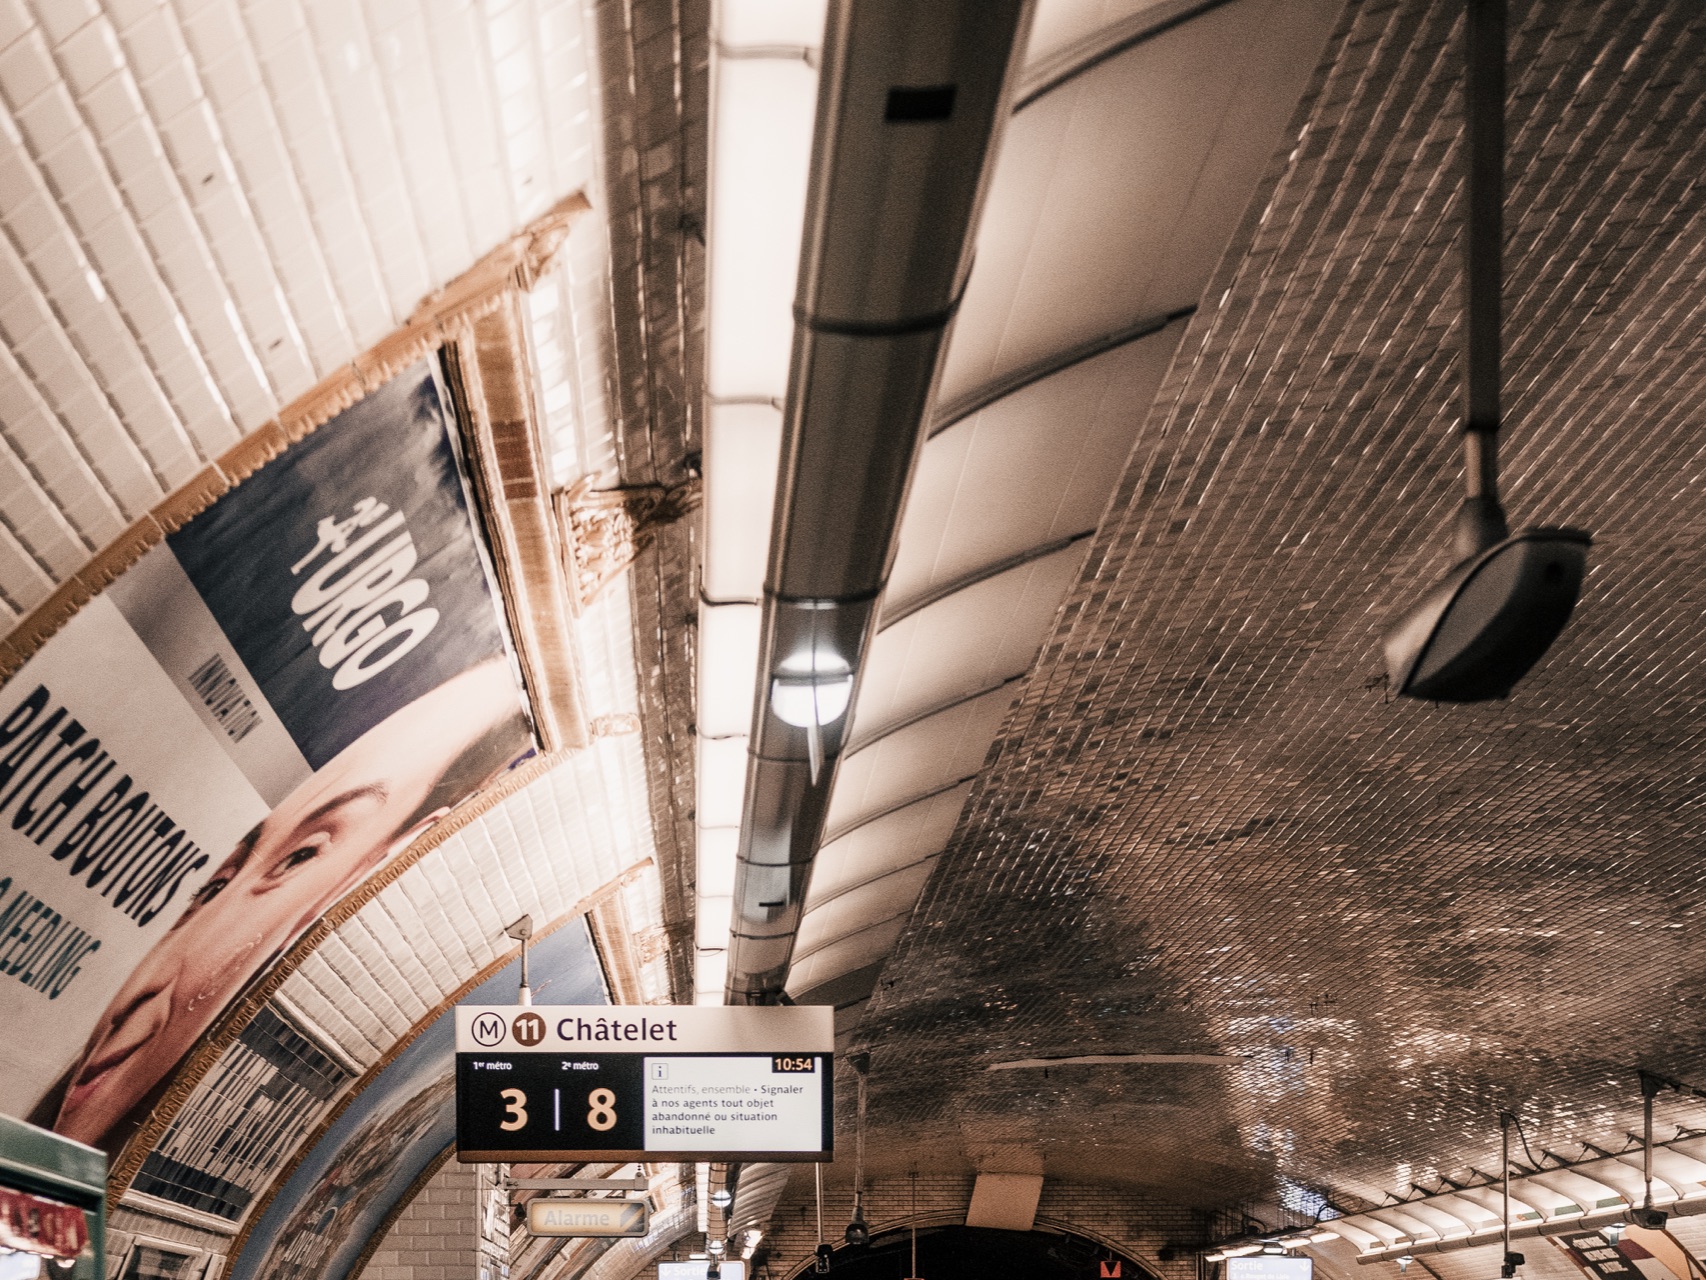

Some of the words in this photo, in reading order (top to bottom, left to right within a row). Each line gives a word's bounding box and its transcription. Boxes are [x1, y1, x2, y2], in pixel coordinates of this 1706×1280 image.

[187, 652, 264, 744] INNOVATION
[50, 774, 209, 927] BOUTONS
[516, 1018, 540, 1041] 11
[557, 1017, 677, 1041] Châtelet
[486, 1061, 513, 1070] métro
[573, 1061, 599, 1070] métro
[774, 1058, 813, 1071] 10:54
[652, 1085, 699, 1095] Attentifs,
[701, 1085, 751, 1094] ensemble
[760, 1085, 804, 1096] Signaler
[500, 1087, 529, 1132] 3
[587, 1087, 617, 1132] 8
[652, 1099, 658, 1108] à
[661, 1100, 680, 1108] nos
[683, 1099, 718, 1109] agents
[721, 1099, 743, 1108] tout
[746, 1099, 774, 1109] objet
[152, 1037, 279, 1174] MAIRIE
[220, 1081, 325, 1194] LILAS
[652, 1112, 711, 1121] abandonné
[730, 1112, 778, 1121] situation
[652, 1125, 716, 1135] inhabituelle
[543, 1209, 610, 1226] Alarme
[673, 1266, 705, 1277] Sortie
[1231, 1260, 1264, 1271] Sortie
